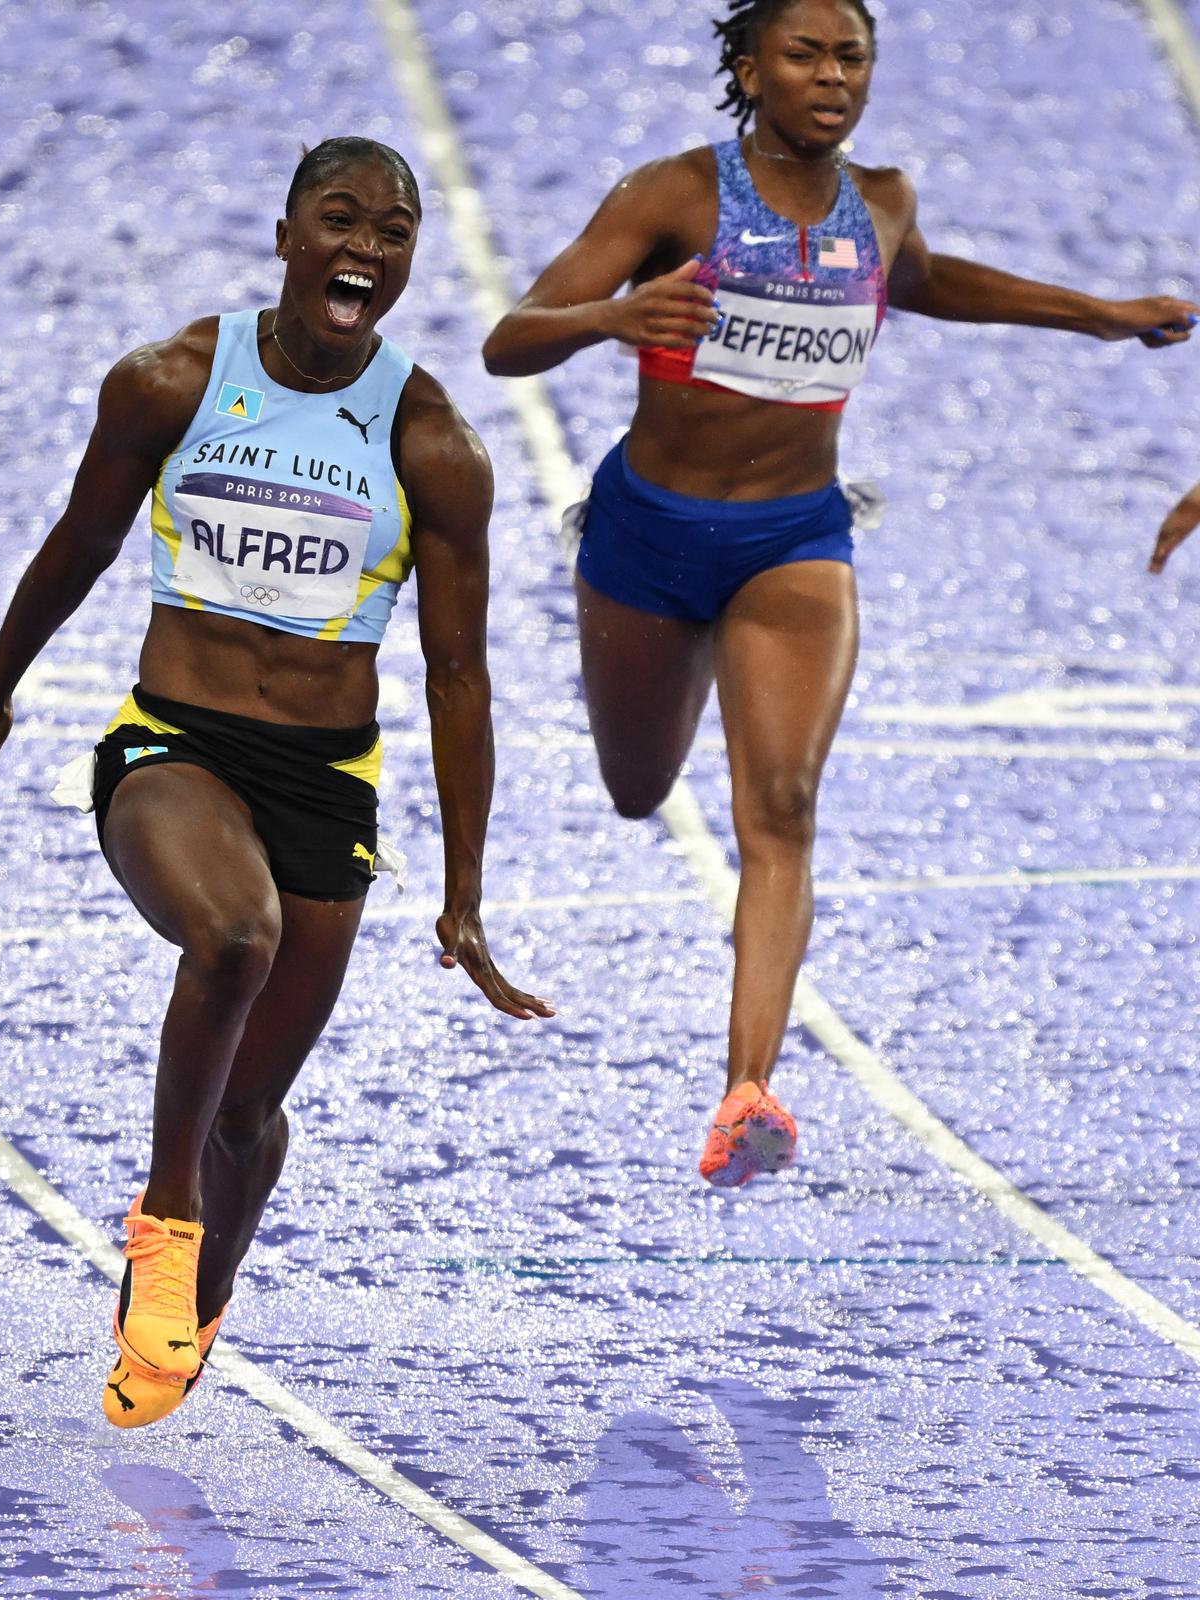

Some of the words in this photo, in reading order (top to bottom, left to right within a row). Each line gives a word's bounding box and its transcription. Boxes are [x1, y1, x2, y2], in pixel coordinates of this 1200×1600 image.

[766, 282, 809, 298] PARIS
[814, 287, 846, 301] 2024
[193, 443, 277, 469] SAINT
[292, 455, 370, 500] LUCIA
[225, 482, 273, 499] PARIS
[279, 491, 322, 507] 2024
[190, 518, 349, 575] ALFRED
